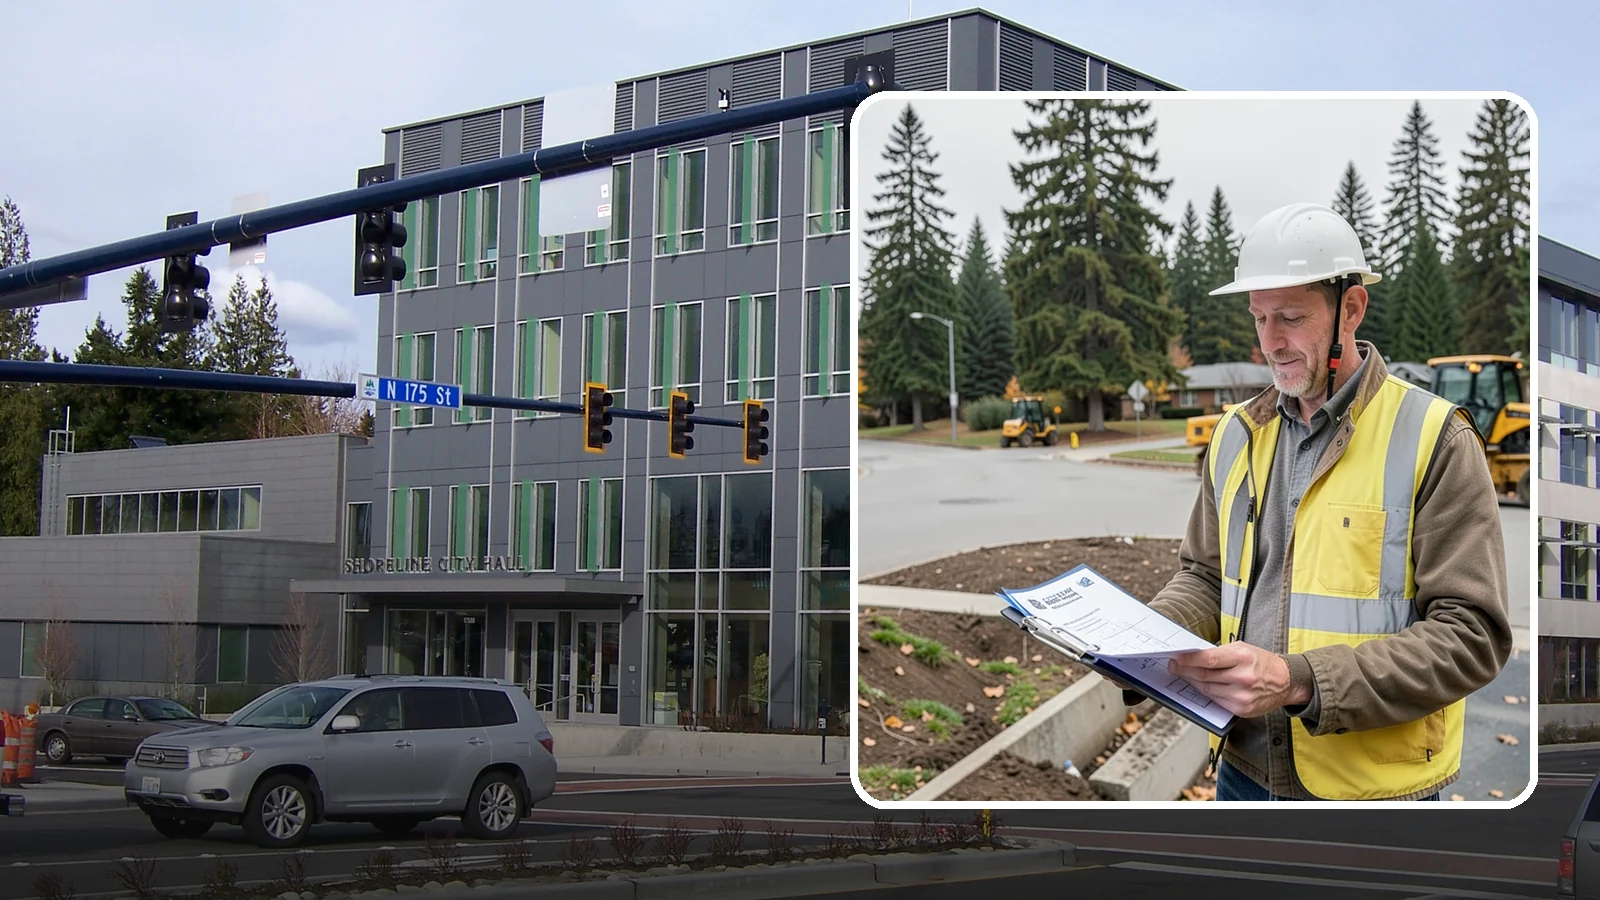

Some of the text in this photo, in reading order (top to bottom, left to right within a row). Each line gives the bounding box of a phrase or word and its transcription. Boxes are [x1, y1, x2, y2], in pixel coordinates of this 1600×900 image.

[387, 381, 451, 406] N 175 St
[344, 555, 526, 574] SHORELINE CITY HALL
